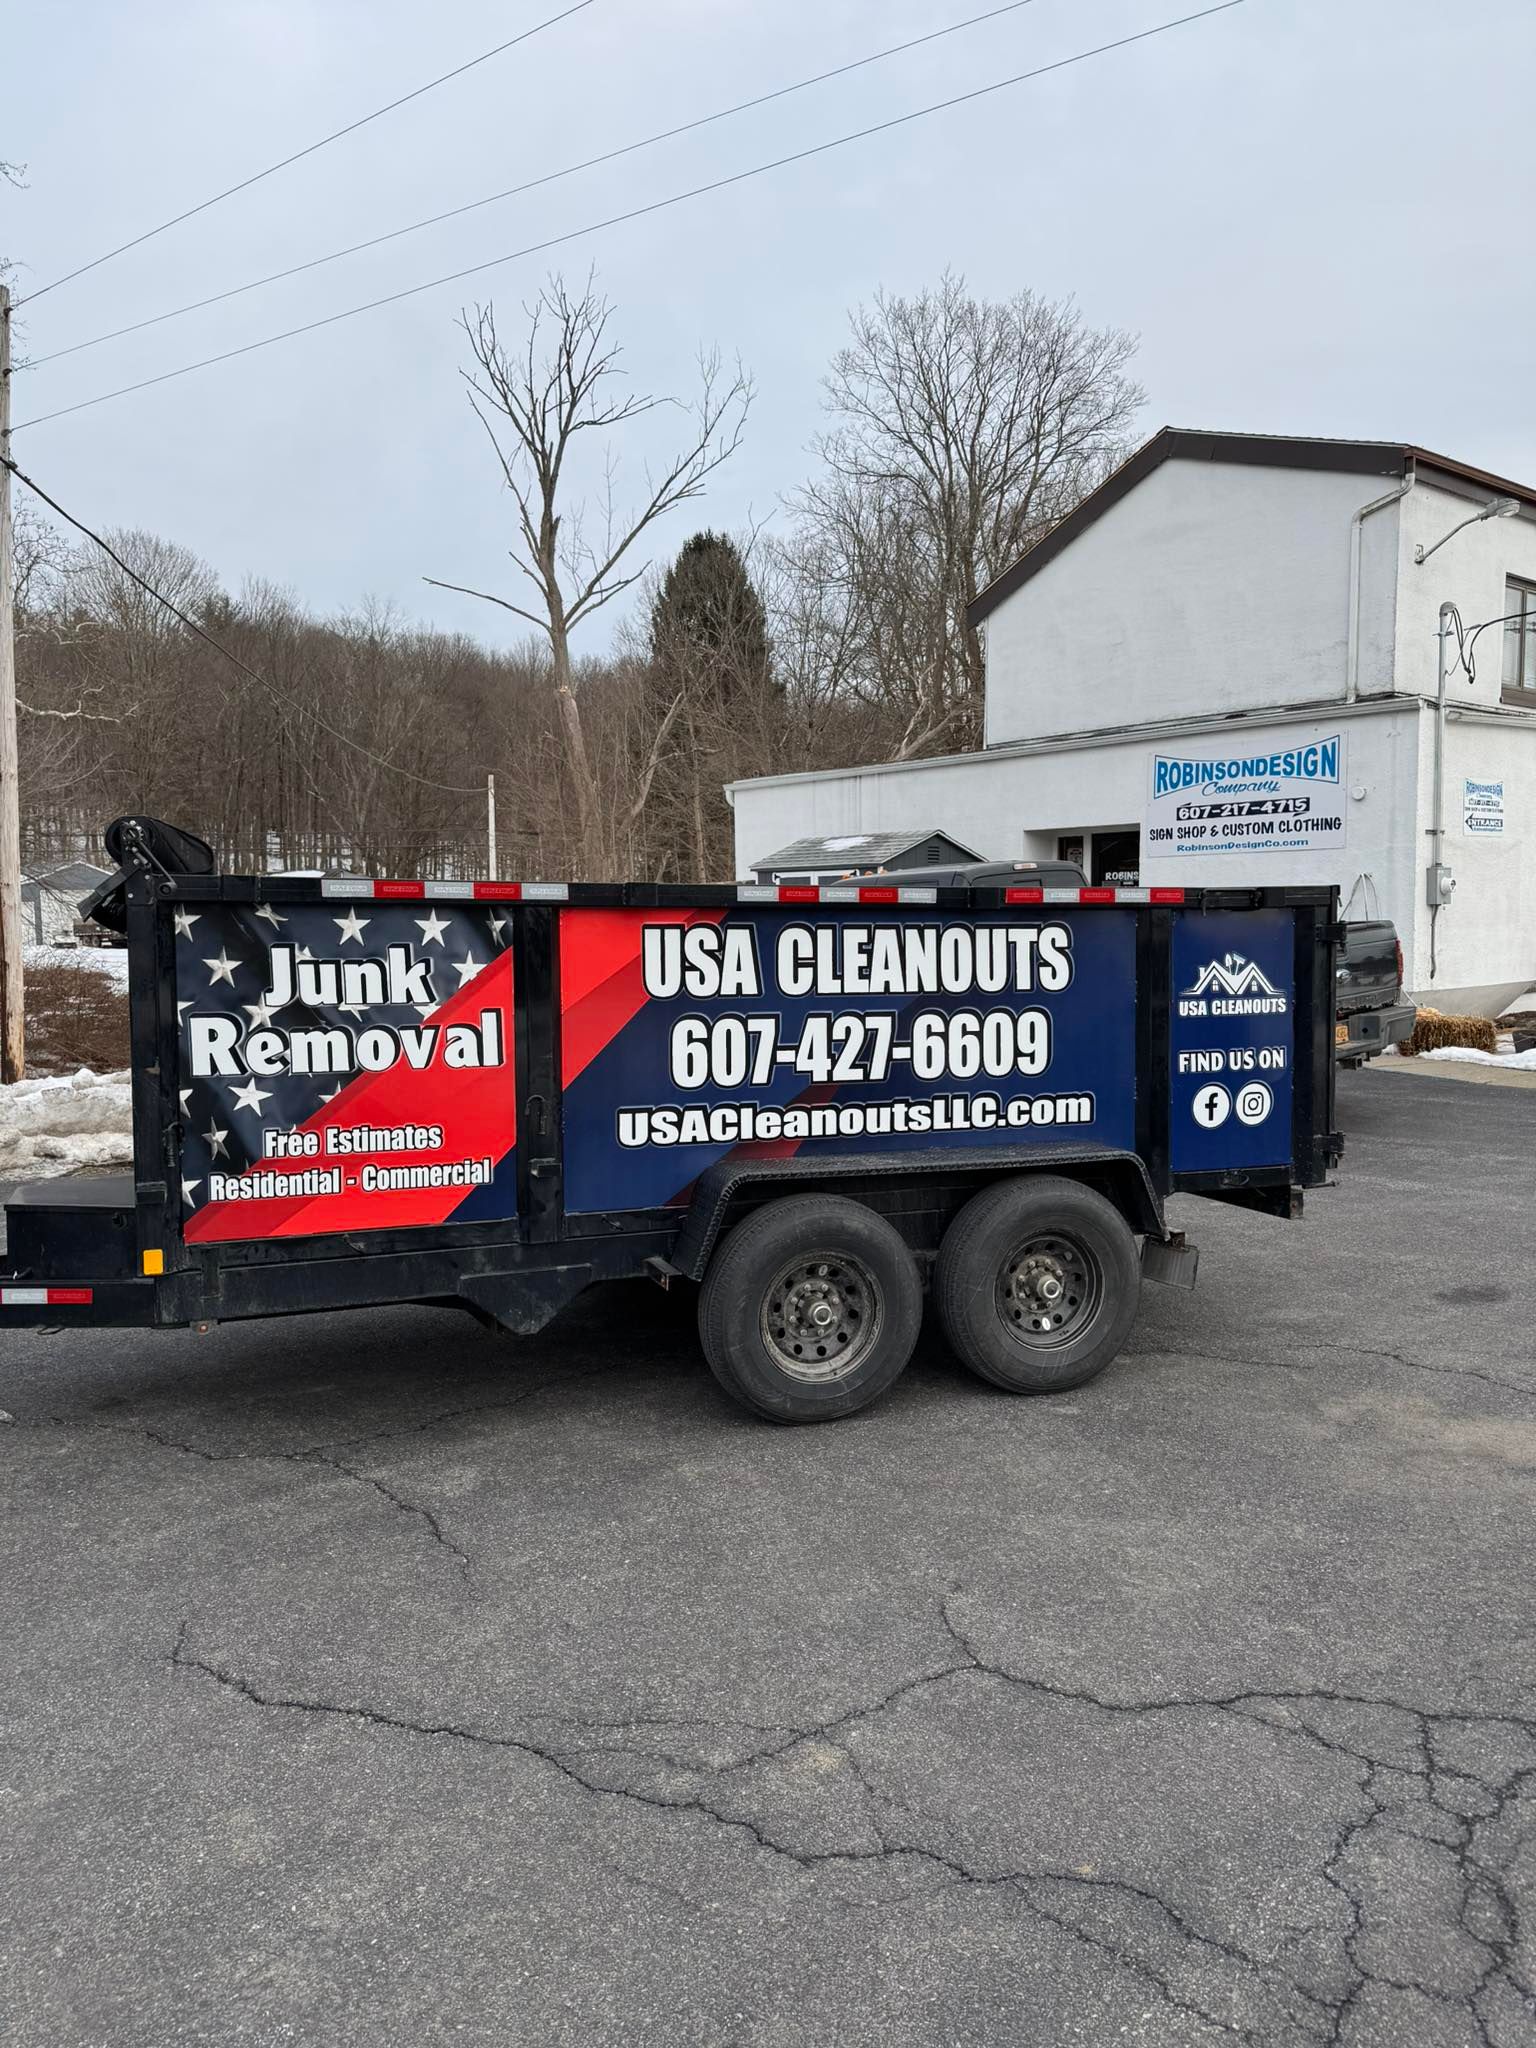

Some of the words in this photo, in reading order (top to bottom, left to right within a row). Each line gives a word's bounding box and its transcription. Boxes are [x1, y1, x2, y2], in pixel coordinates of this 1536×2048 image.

[1156, 741, 1336, 794] ROBINSONDESIGN
[1201, 780, 1281, 797] Company
[1178, 798, 1308, 820] 607-217-4715
[1468, 818, 1501, 827] ENTRANCE
[1149, 827, 1173, 841] SIGN
[1177, 825, 1206, 839] SHOP
[1210, 824, 1219, 837] &
[1222, 821, 1274, 836] CUSTOM
[1279, 817, 1342, 833] CLOTHING
[1176, 839, 1309, 852] RobinsonDesignCo.com
[263, 942, 437, 1007] Junk
[643, 923, 762, 998] USA
[776, 921, 1073, 997] CLEANOUTS
[1179, 1000, 1207, 1016] USA
[1211, 998, 1286, 1015] CLEANOUTS
[188, 1008, 505, 1077] Removal
[671, 1008, 1051, 1089] 607-427-6609
[1179, 1051, 1225, 1073] FIND
[1229, 1049, 1255, 1071] US
[1259, 1047, 1286, 1069] ON
[617, 1092, 1094, 1147] USACleanoutsLLC.com
[263, 1127, 319, 1159] Free
[325, 1123, 443, 1155] Estimates
[209, 1167, 341, 1201] Residential
[361, 1158, 492, 1193] Commercial
